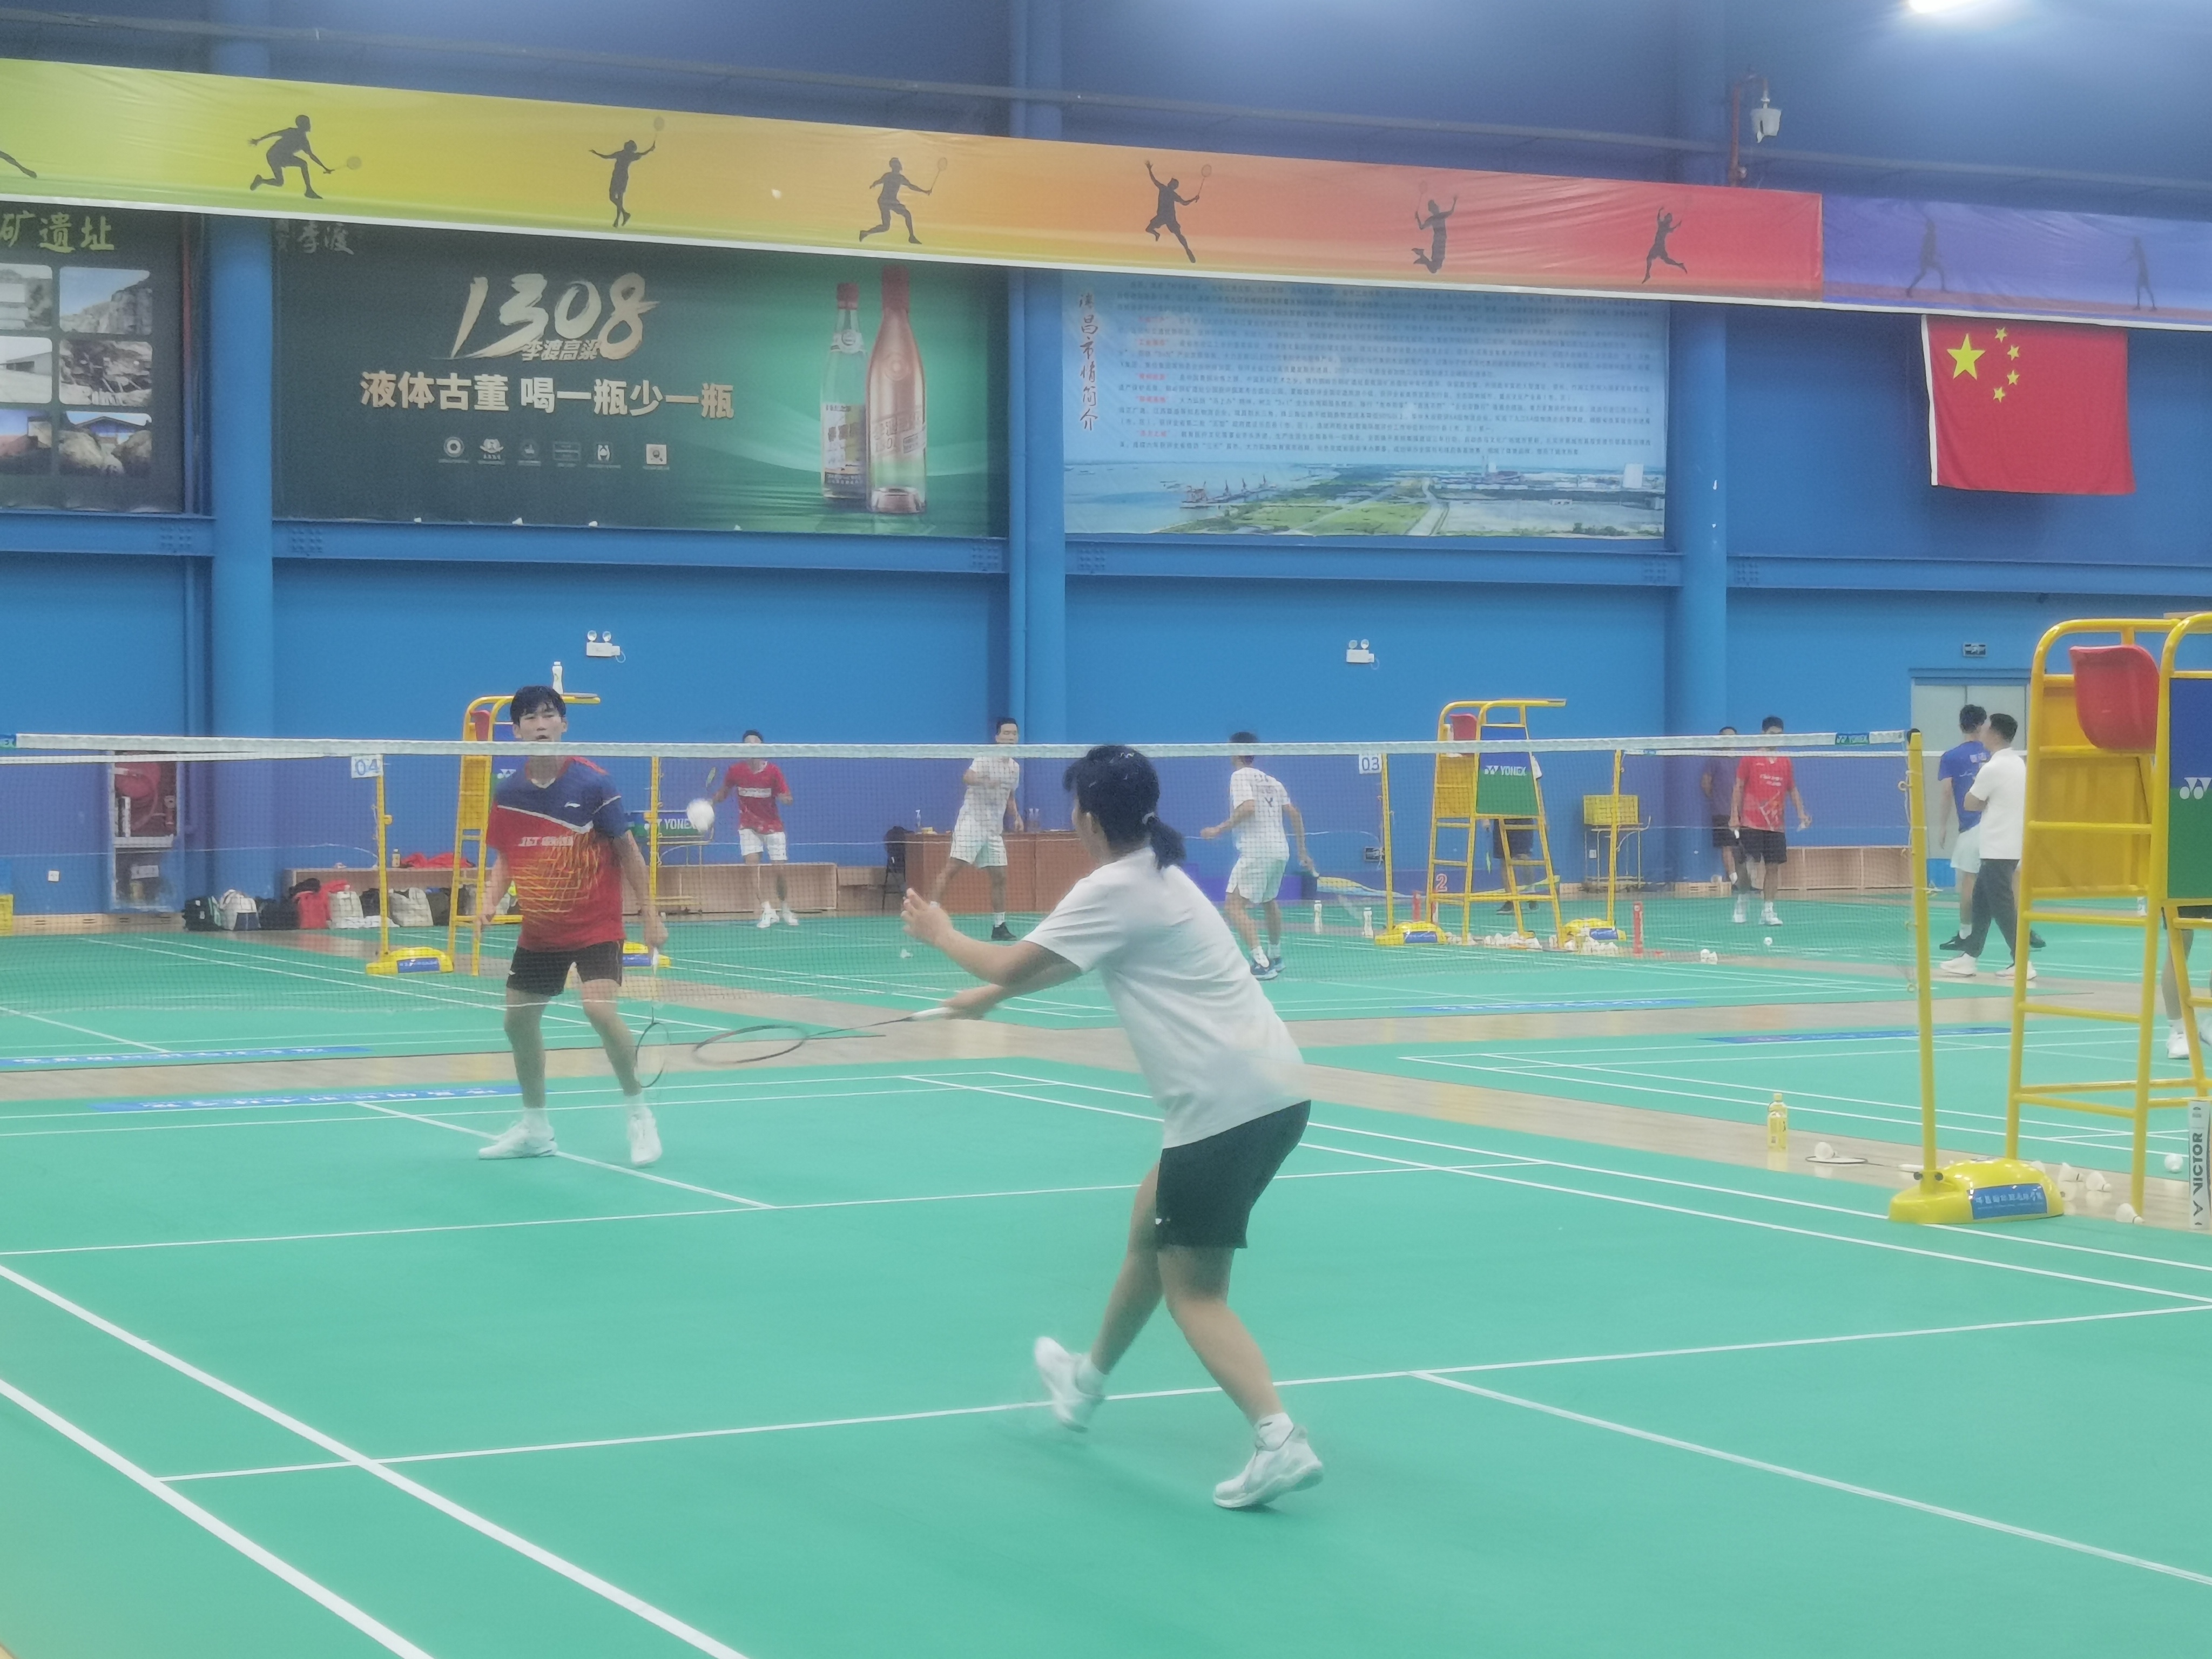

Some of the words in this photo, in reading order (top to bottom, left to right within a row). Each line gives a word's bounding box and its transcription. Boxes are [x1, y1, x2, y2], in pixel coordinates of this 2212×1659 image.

[0, 210, 114, 253] 矿遗址
[432, 267, 660, 360] 1308
[360, 370, 509, 411] 液体古董
[521, 377, 734, 419] 喝一瓶少一瓶
[355, 759, 380, 776] 04
[1362, 757, 1379, 771] 03
[664, 818, 697, 830] YONE
[1435, 873, 1448, 892] 2
[2192, 1132, 2203, 1196] VICTOR
